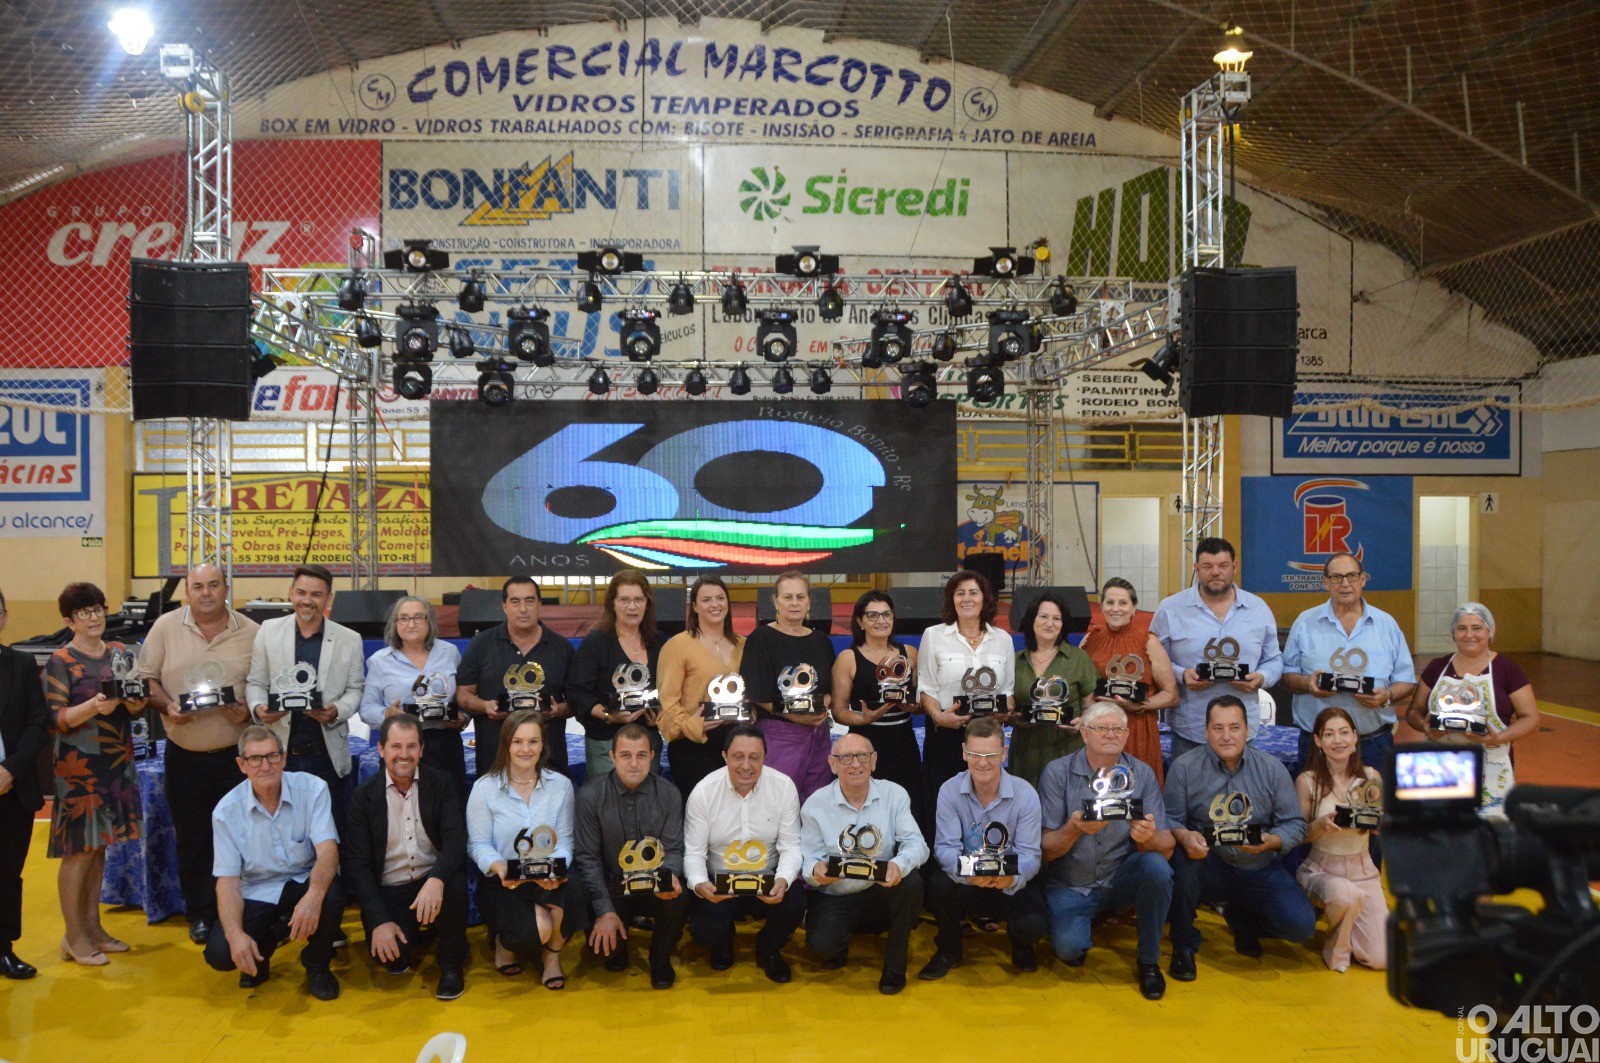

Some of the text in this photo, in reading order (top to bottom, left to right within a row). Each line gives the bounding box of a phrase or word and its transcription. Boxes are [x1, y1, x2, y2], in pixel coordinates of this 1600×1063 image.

[407, 38, 952, 112] COMERCIAL MARCOTTO
[513, 93, 860, 119] VIDROS TEMPERADOS
[260, 118, 298, 133] BOX
[304, 118, 330, 133] EM
[338, 118, 395, 134] VIDRO
[415, 118, 483, 134] VIDROS
[491, 119, 622, 134] TRABALHADOS
[629, 120, 676, 135] COM:
[684, 121, 745, 136] BISOTE
[762, 119, 835, 138] INSISÃO
[855, 125, 953, 141] SERIGRAFIA
[972, 128, 1015, 144] JATO
[1021, 130, 1043, 144] DE
[1048, 132, 1097, 147] AREIA
[389, 169, 680, 210] BONFANTI
[802, 168, 970, 217] Sicredi
[47, 205, 151, 218] GRUPO
[430, 237, 491, 250] ONSTRUÇÃO
[499, 237, 575, 250] CONSTRUTORA
[659, 323, 696, 345] EÍCULOS
[1082, 374, 1138, 384] SEBERI
[1081, 398, 1139, 407] RODEIO
[759, 406, 844, 428] Rodeio
[1297, 436, 1486, 456] Melhor porque é nosso
[482, 420, 886, 545] 60
[12, 512, 94, 535] alcance!
[242, 541, 281, 551] Obras
[378, 539, 431, 551] Comerci
[255, 553, 281, 563] 3798
[509, 554, 590, 567] ANOS
